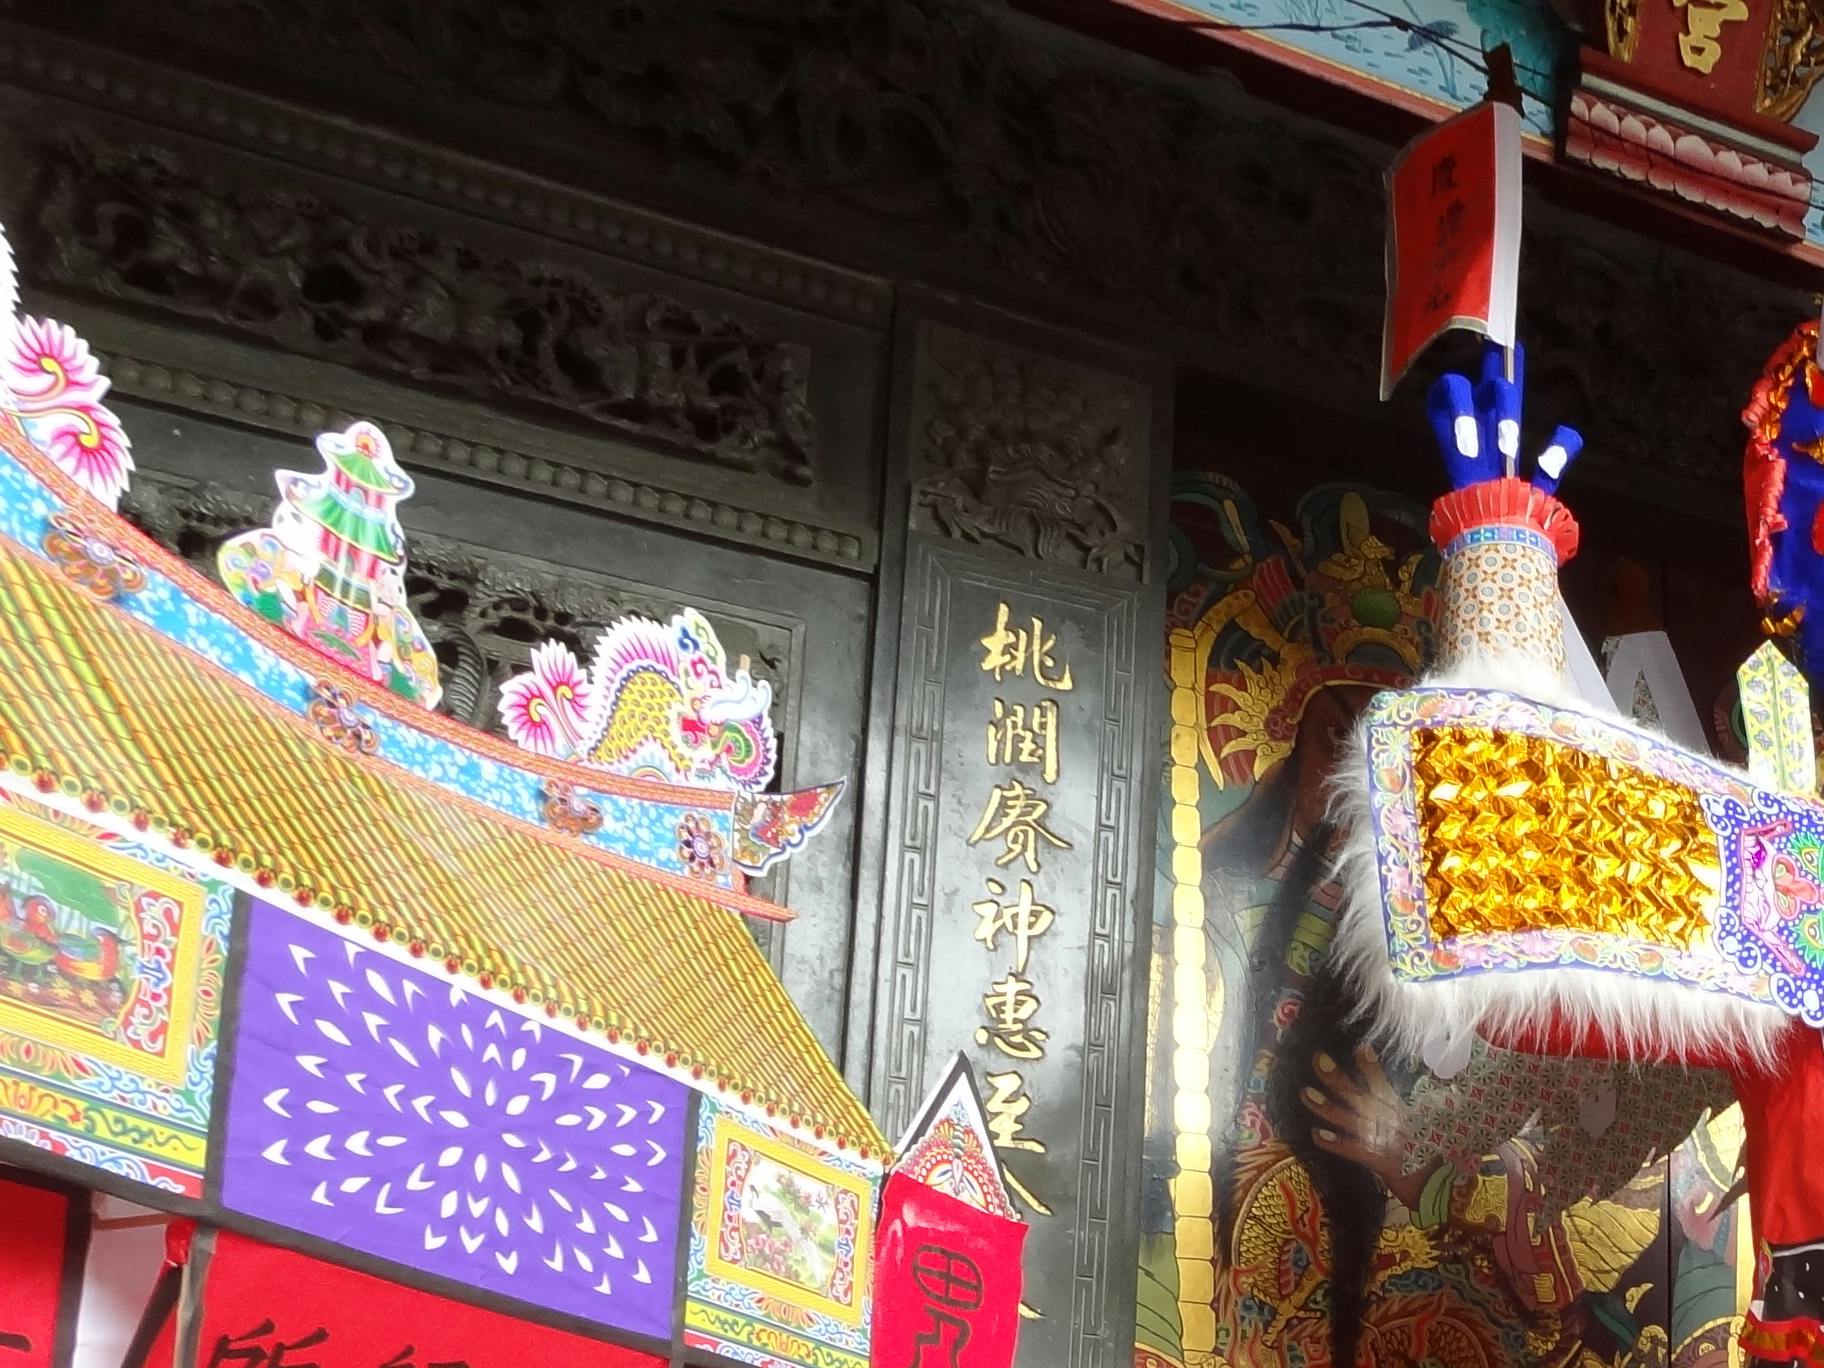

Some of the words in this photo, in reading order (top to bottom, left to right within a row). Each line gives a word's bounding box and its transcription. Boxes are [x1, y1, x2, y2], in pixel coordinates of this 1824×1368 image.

[966, 602, 1073, 1217] 桃潤賡神惠至
